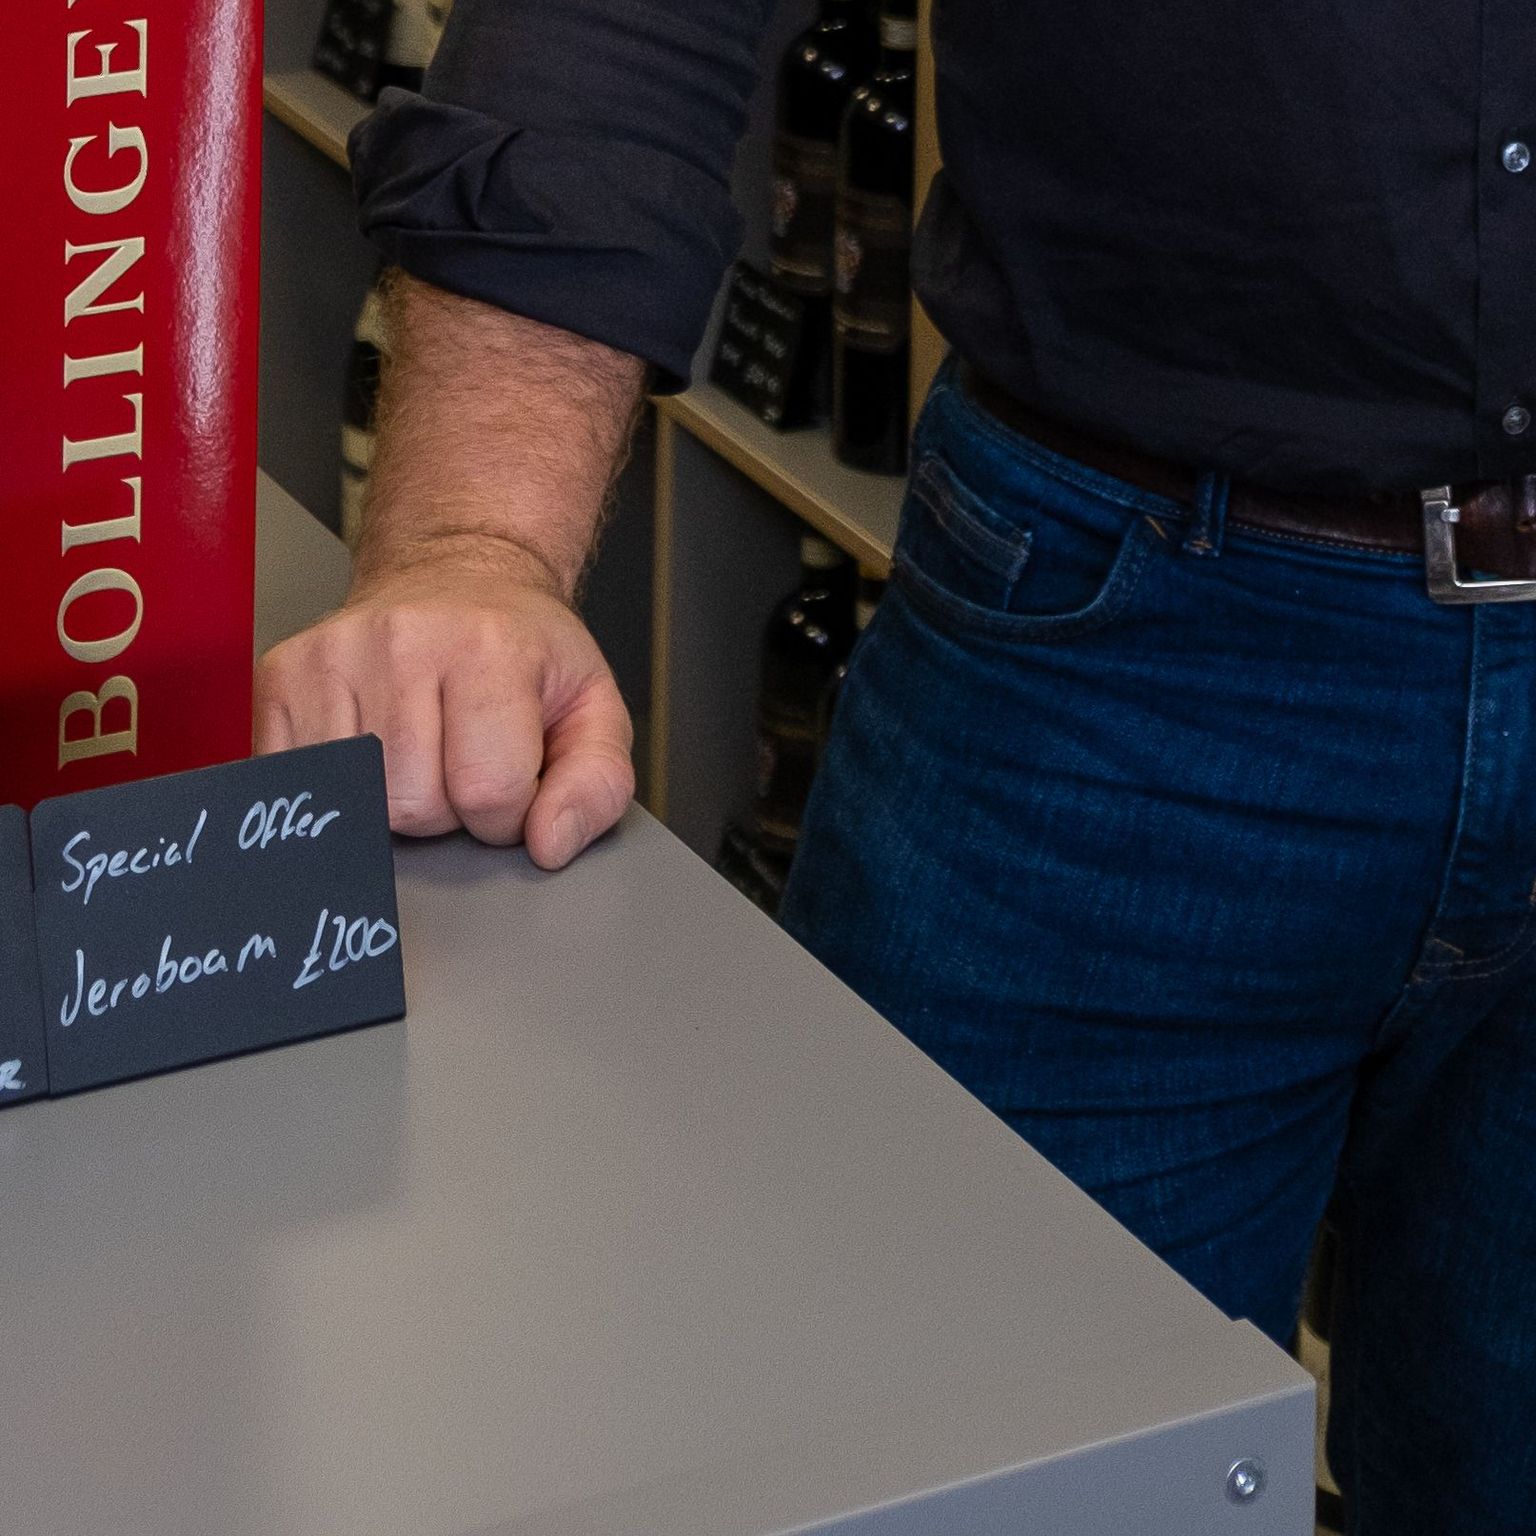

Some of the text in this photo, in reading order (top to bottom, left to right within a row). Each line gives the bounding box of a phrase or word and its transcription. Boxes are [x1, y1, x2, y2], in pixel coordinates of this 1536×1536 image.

[61, 791, 341, 905] Special Offer
[60, 909, 398, 1028] Jeroboam £200
